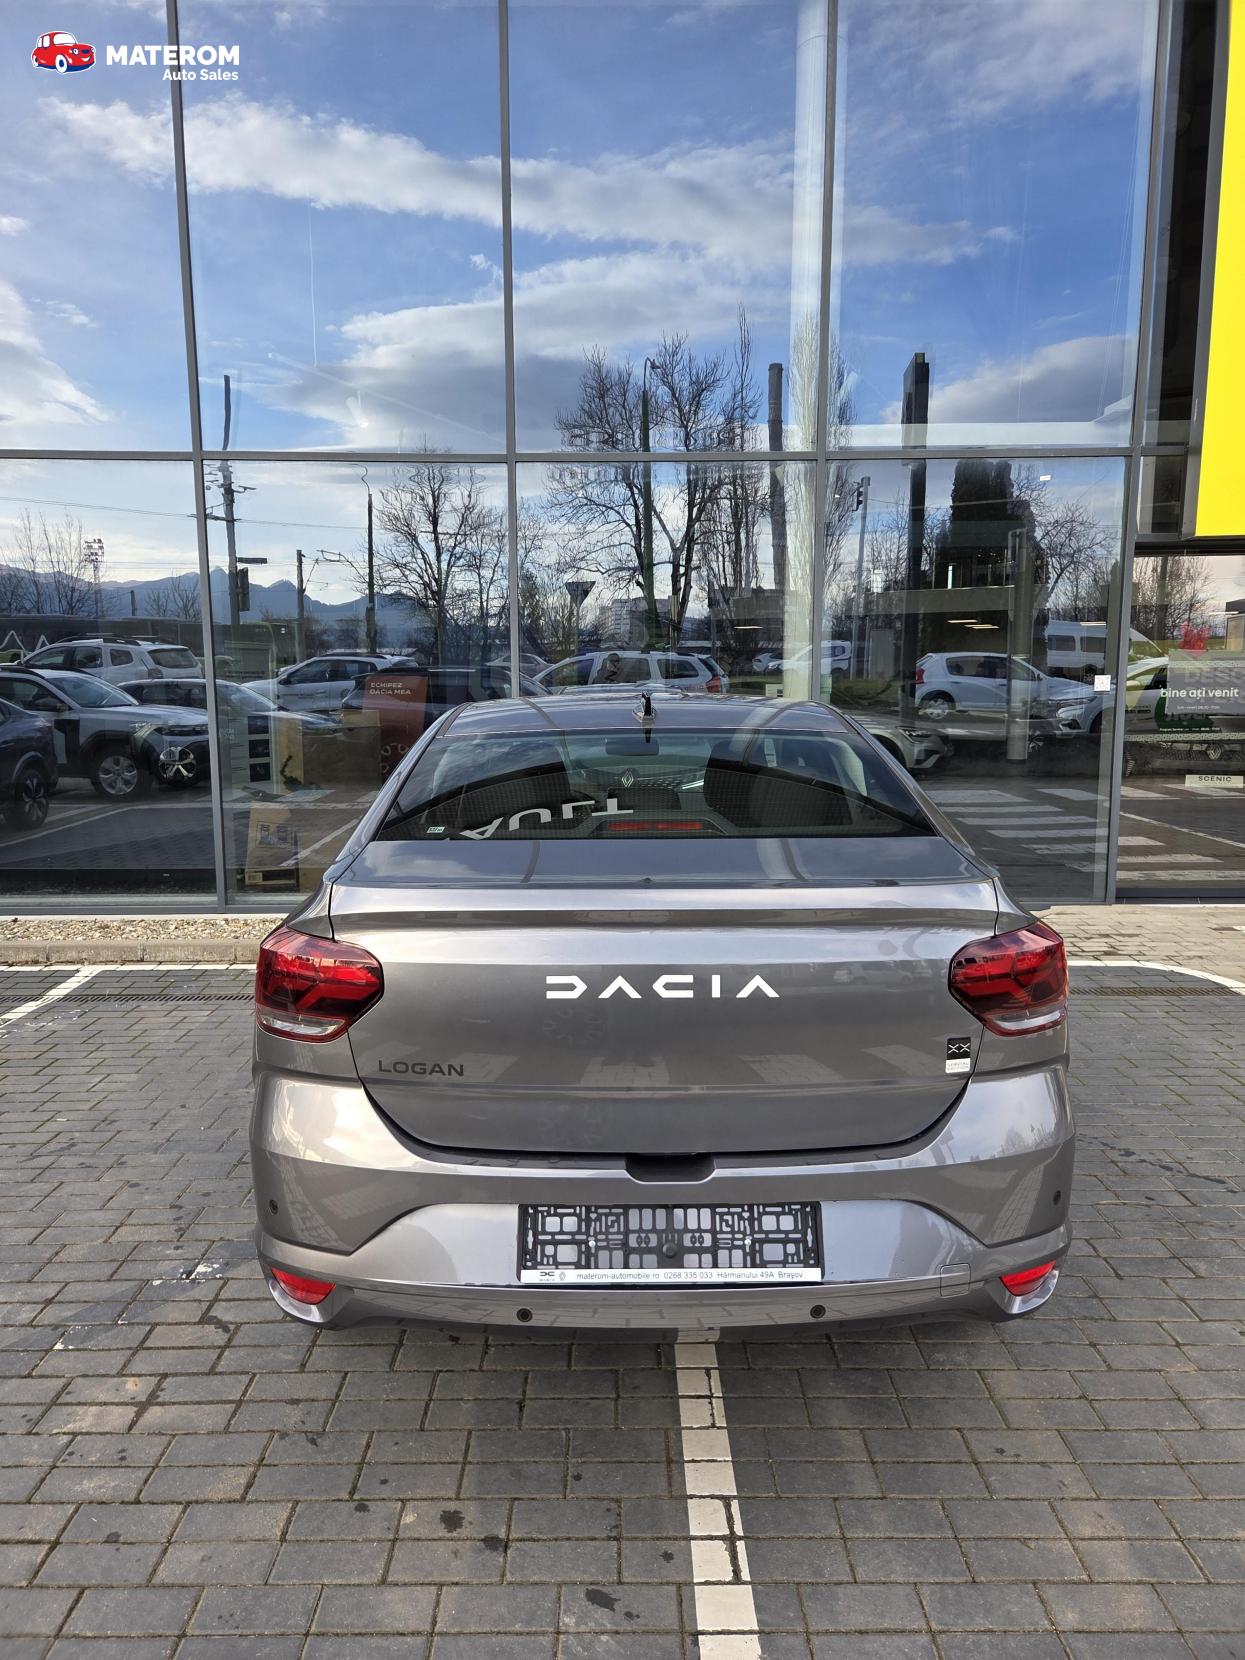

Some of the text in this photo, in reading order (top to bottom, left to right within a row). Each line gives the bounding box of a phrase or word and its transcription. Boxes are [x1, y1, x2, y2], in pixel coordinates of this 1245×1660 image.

[1160, 687, 1187, 698] bine
[1208, 687, 1239, 698] venit
[545, 974, 781, 999] DACIA
[378, 1060, 464, 1077] LOGAN
[576, 1271, 660, 1280] materom-automobile.ro
[663, 1270, 682, 1279] 0268
[683, 1270, 697, 1279] 335
[699, 1271, 713, 1279] 033
[759, 1271, 775, 1279] 49A
